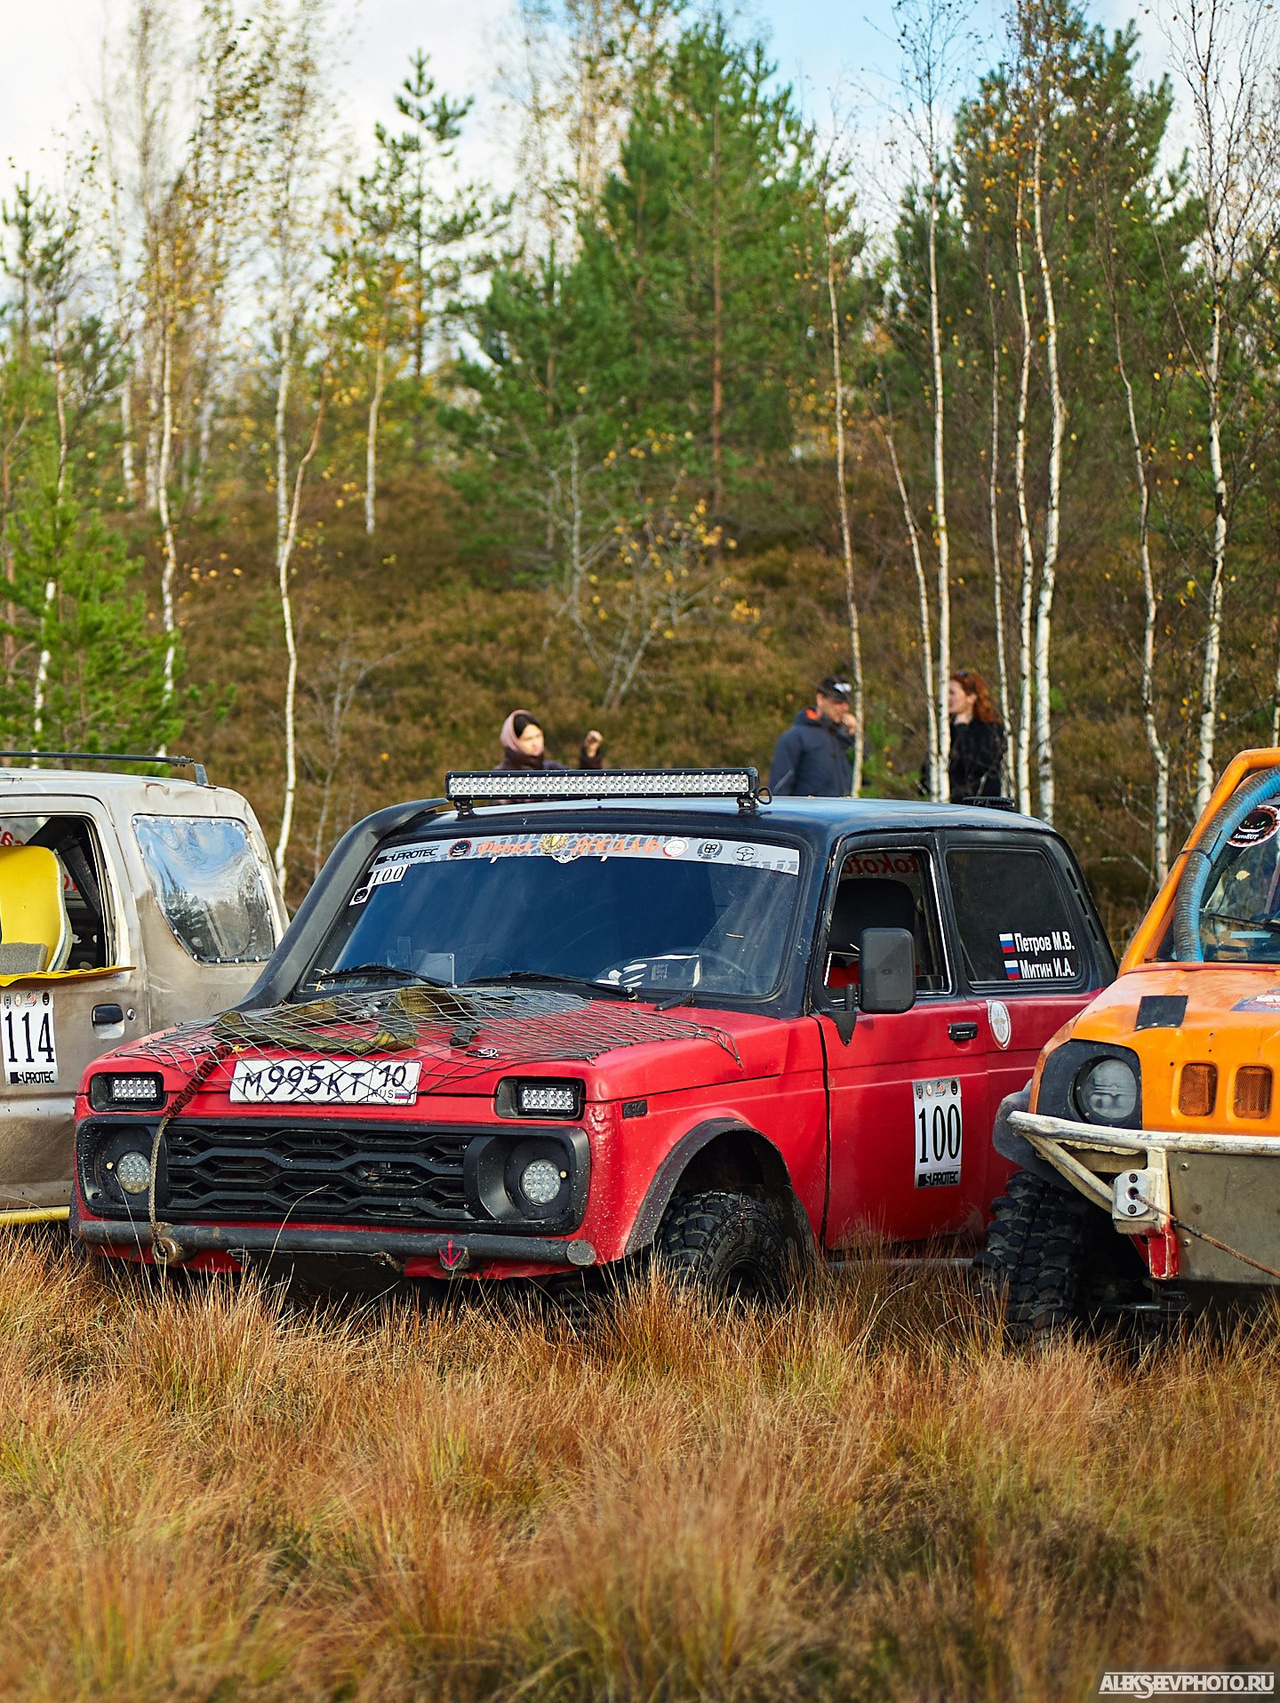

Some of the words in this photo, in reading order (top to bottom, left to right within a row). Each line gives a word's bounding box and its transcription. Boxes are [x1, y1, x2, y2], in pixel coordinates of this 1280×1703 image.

[386, 848, 439, 861] SUPROTEC
[570, 837, 660, 855] ДОСААФ
[372, 866, 405, 884] 100
[1014, 933, 1052, 956] Петров
[1052, 931, 1075, 951] М.В.
[1020, 960, 1053, 979] Митин
[1053, 957, 1075, 977] И.А.
[5, 1011, 55, 1063] 114
[19, 1071, 55, 1084] SUPROTEC
[379, 1065, 407, 1087] 10
[918, 1104, 960, 1163] 100
[927, 1171, 959, 1186] SUPROTEC
